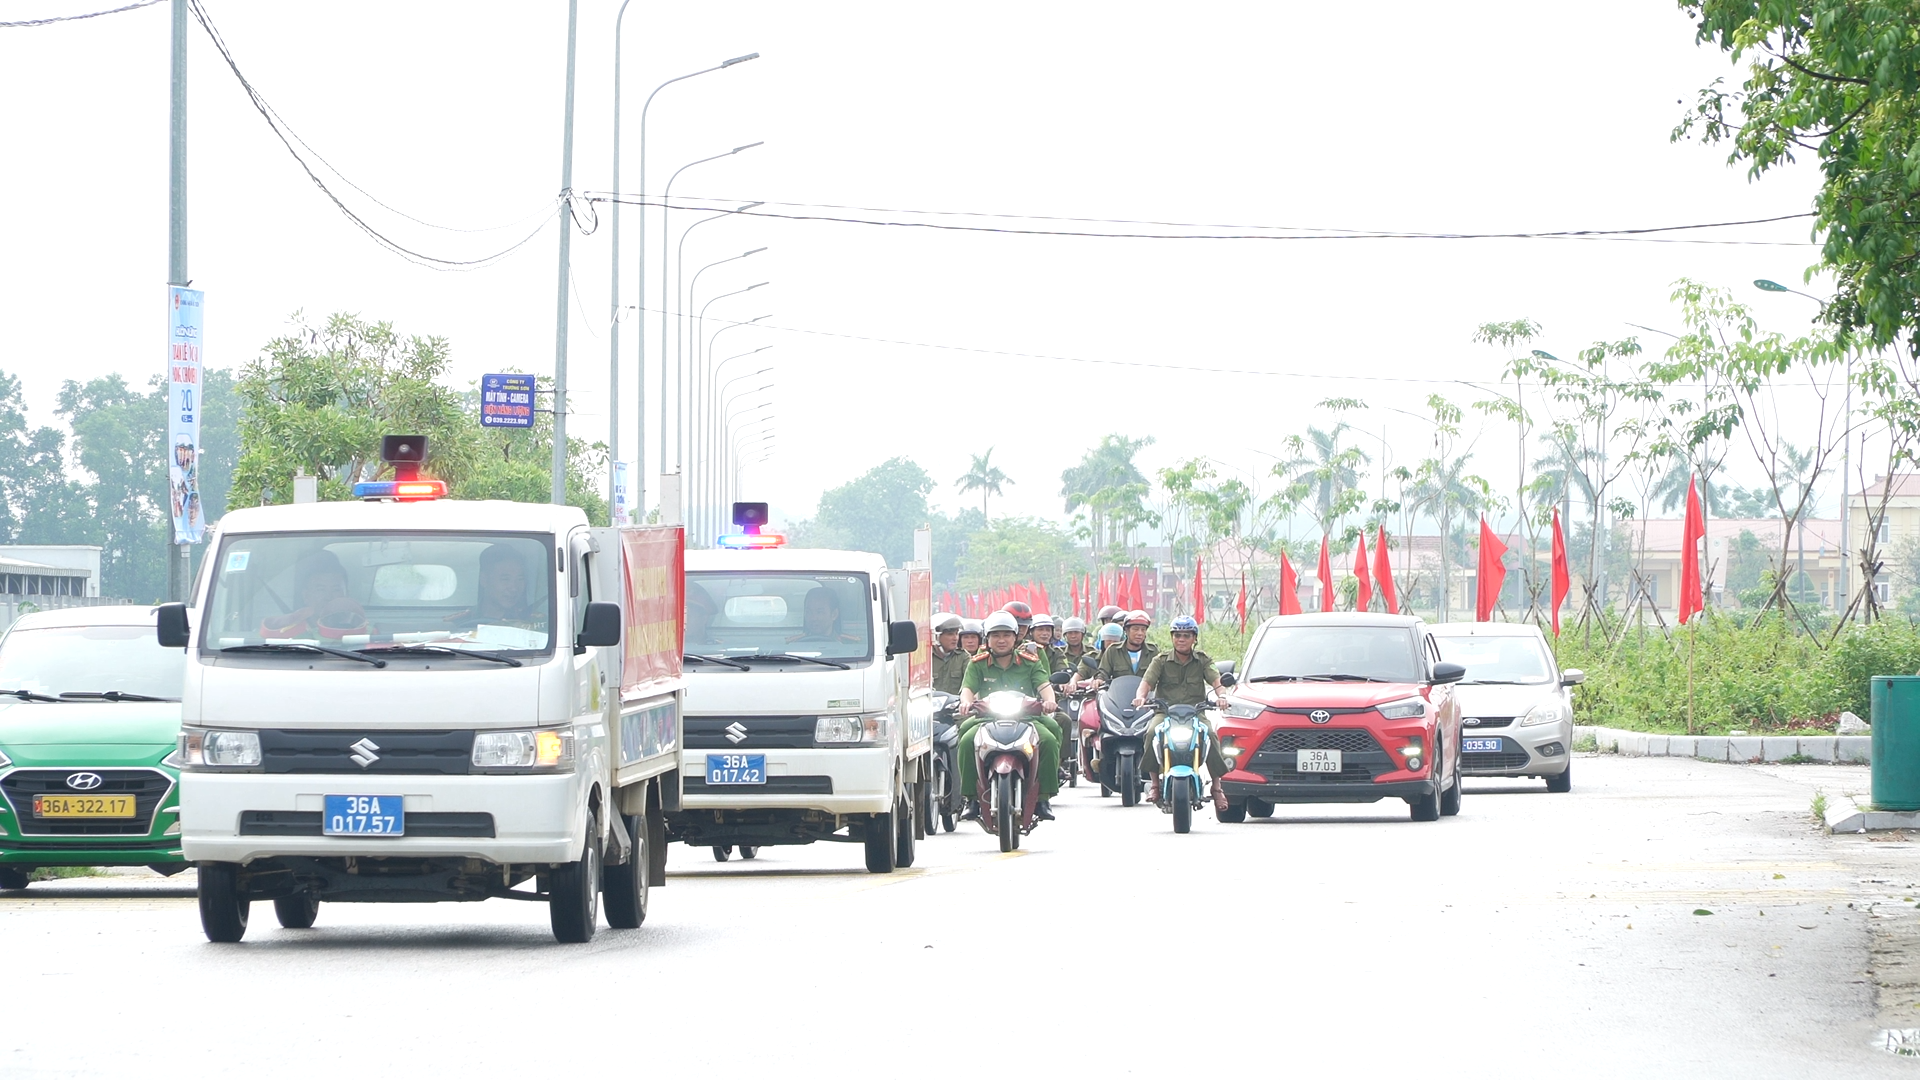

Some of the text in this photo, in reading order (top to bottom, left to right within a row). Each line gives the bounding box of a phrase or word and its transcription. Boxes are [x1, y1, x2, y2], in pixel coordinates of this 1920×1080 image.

[510, 392, 529, 404] CAMERA
[723, 755, 748, 768] 36A
[1310, 751, 1329, 761] 36A
[1302, 761, 1337, 771] 817.03
[712, 769, 760, 782] 017.42
[43, 799, 127, 813] 36A-322.17
[346, 796, 381, 814] 36A
[332, 815, 396, 833] 017.57
